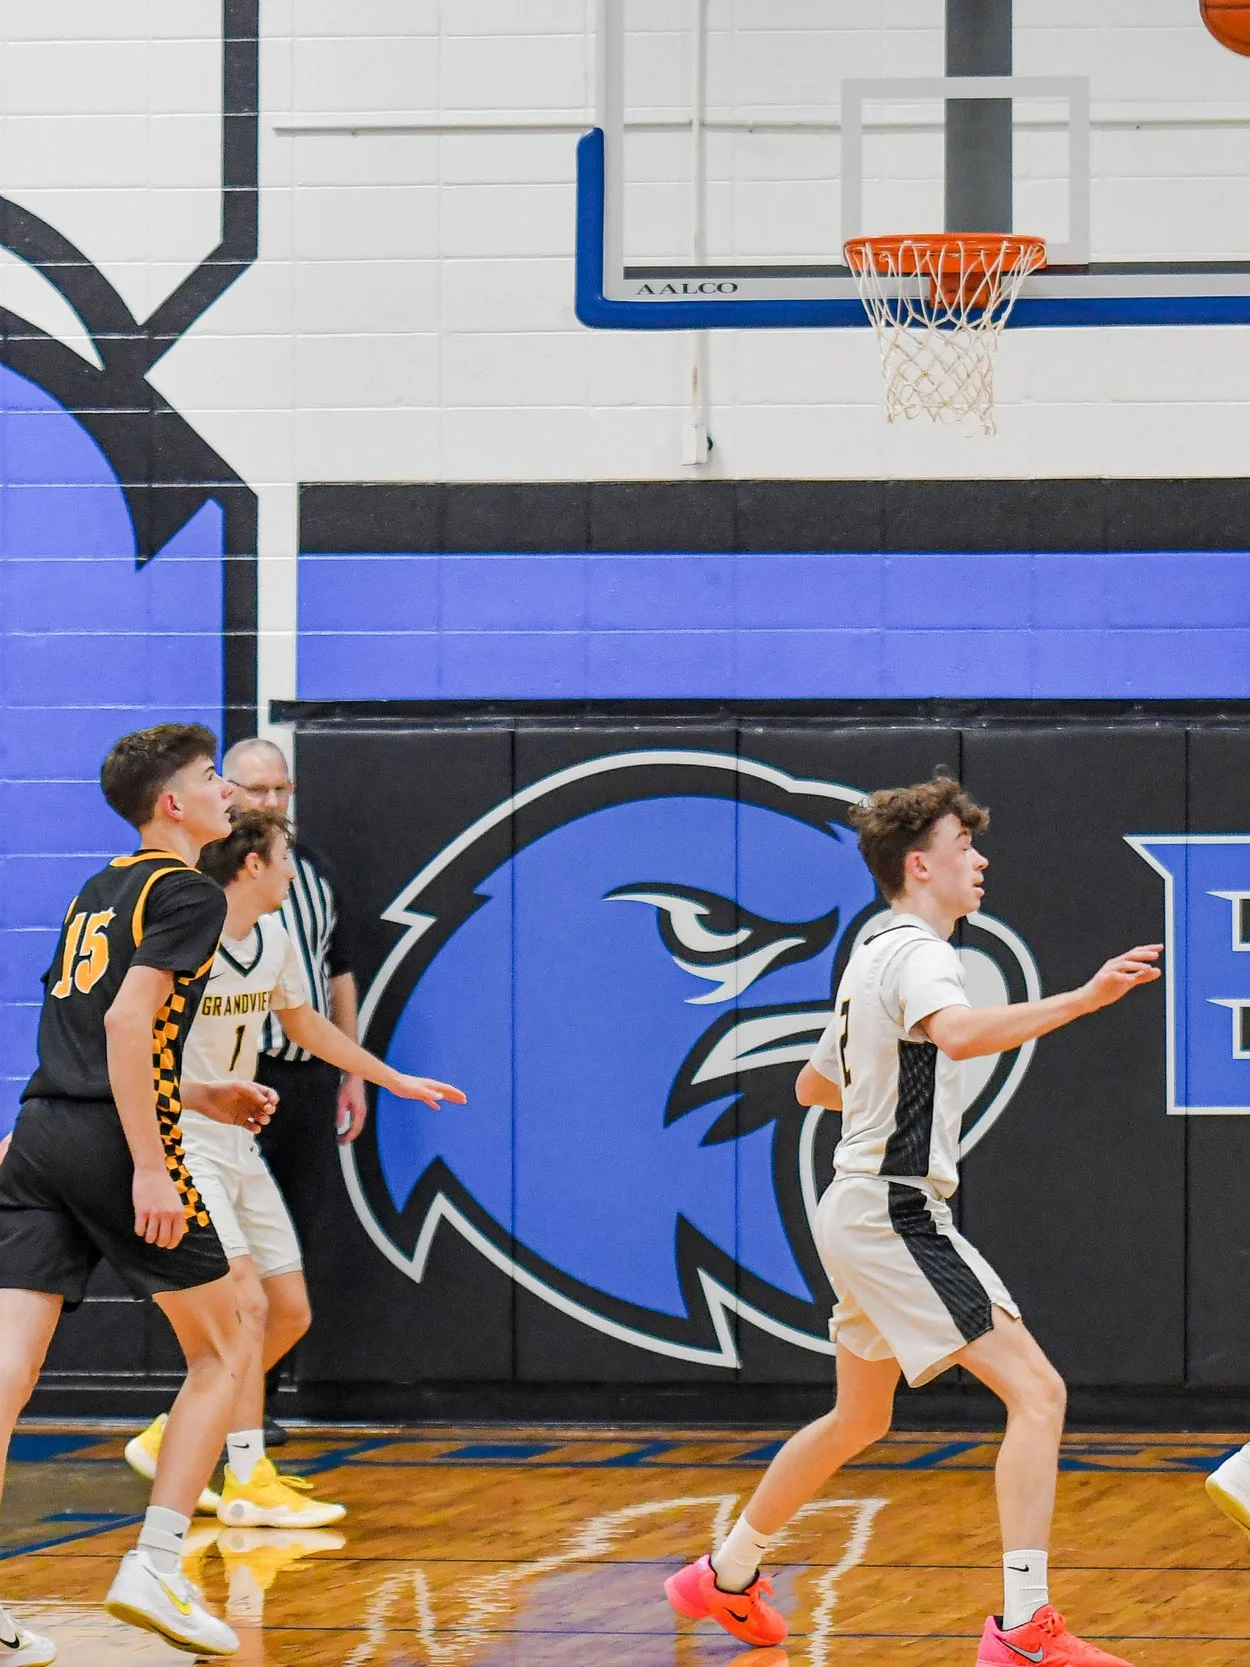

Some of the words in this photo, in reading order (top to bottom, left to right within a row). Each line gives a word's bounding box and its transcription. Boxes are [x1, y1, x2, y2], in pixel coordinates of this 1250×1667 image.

[635, 282, 738, 295] AALCO
[50, 906, 117, 999] 15
[228, 1023, 247, 1072] 1
